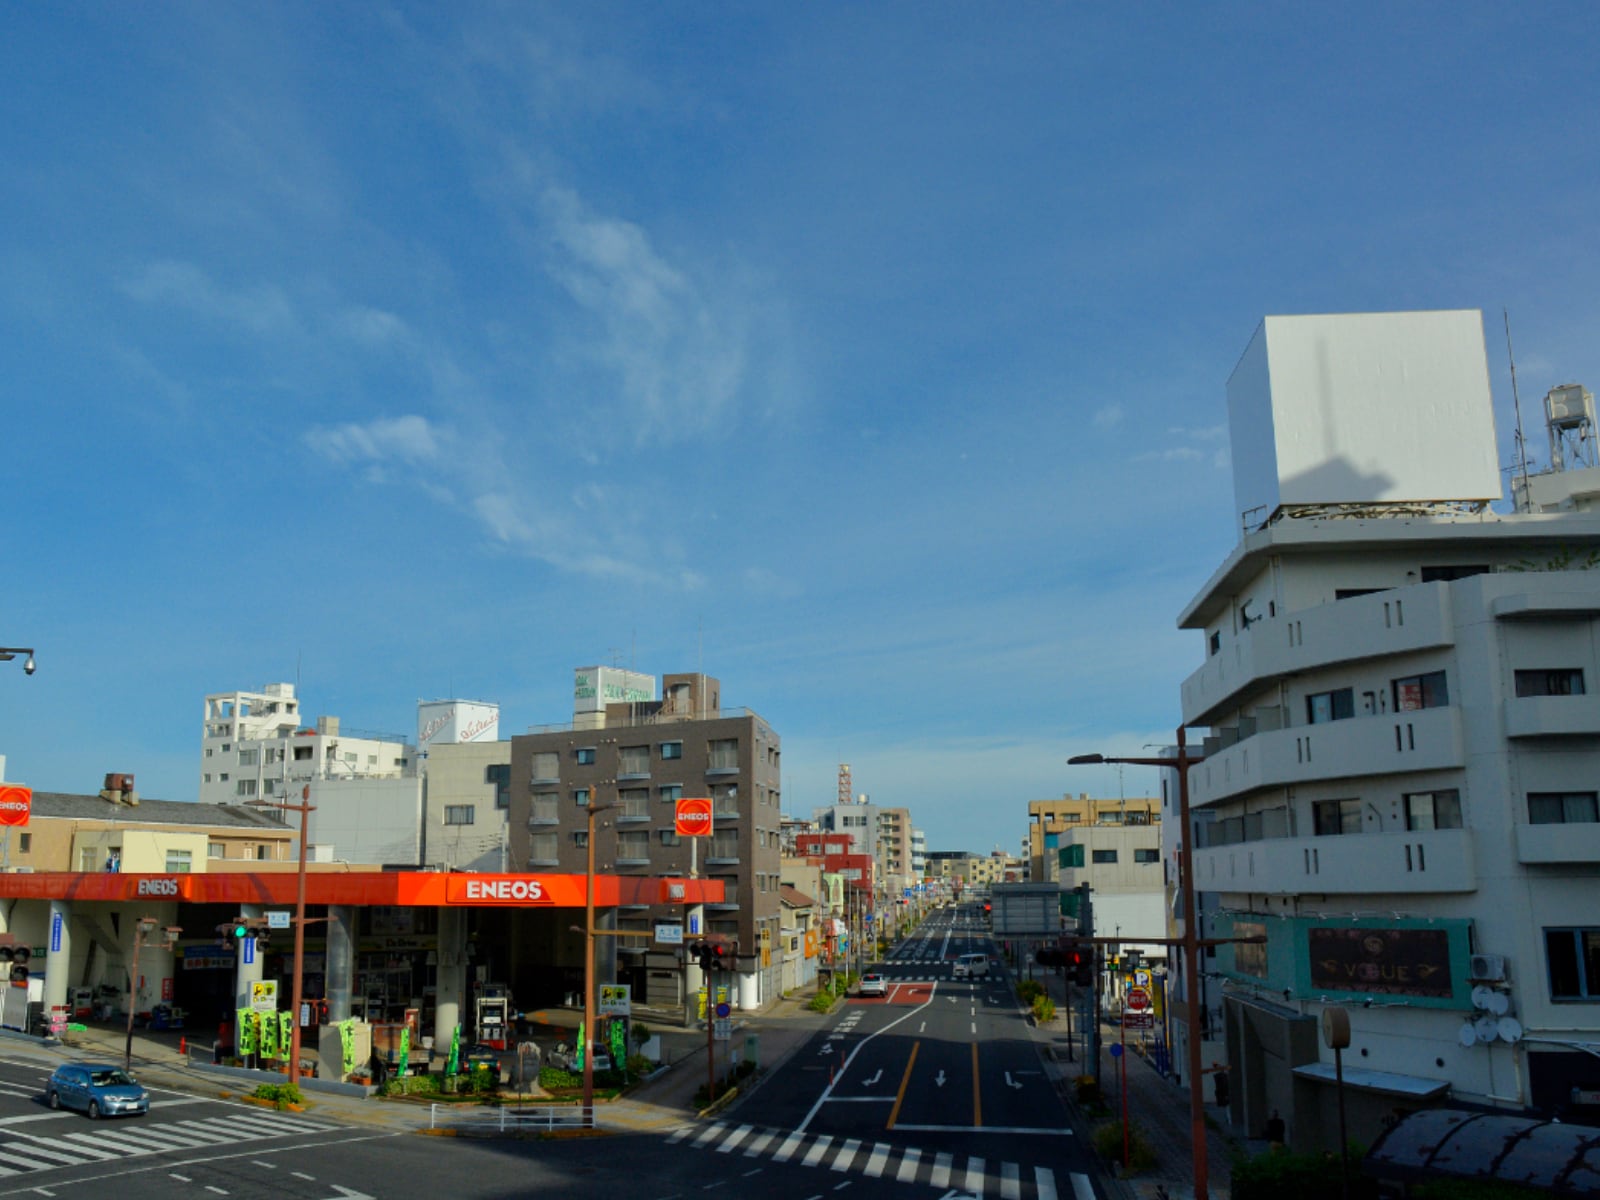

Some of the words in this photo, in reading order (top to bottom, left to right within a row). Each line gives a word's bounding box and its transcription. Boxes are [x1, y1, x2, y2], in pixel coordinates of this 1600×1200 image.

[677, 812, 710, 821] ENEOS
[138, 878, 178, 896] ENEOS
[466, 880, 542, 899] ENEOS
[1136, 972, 1148, 985] P
